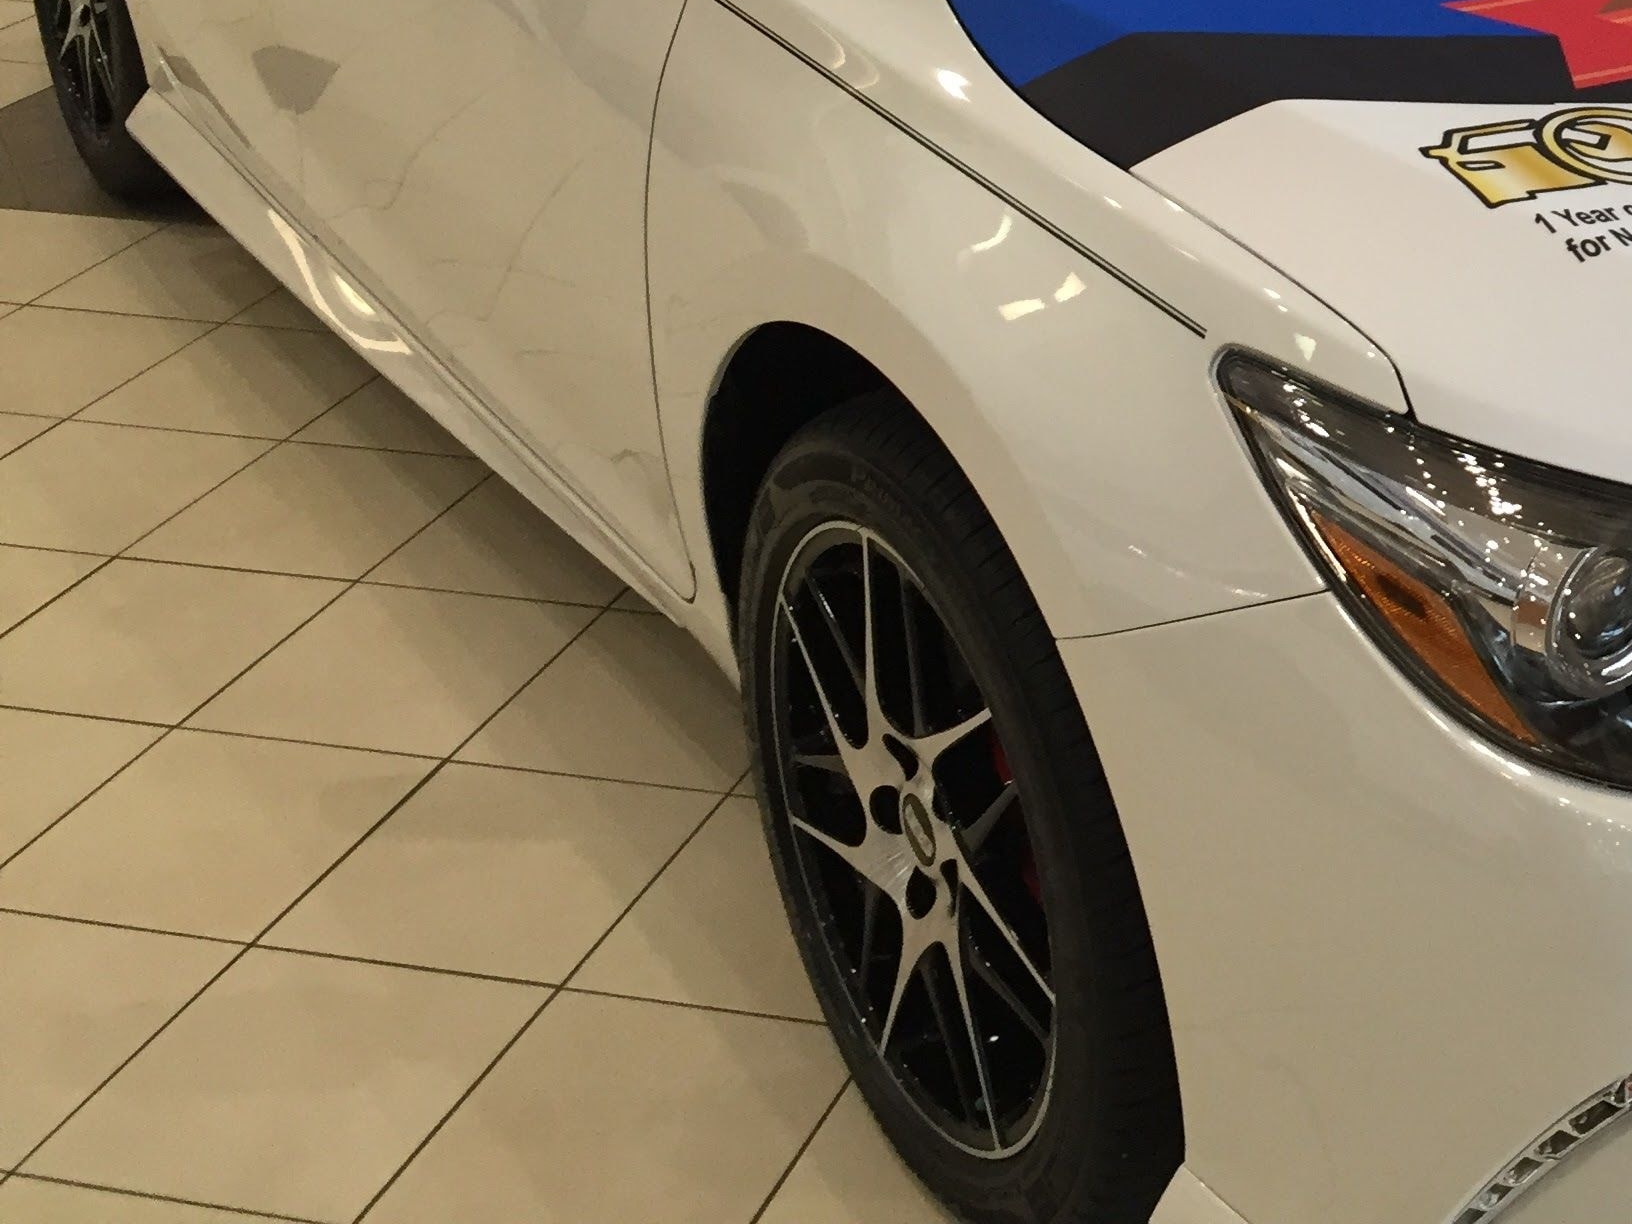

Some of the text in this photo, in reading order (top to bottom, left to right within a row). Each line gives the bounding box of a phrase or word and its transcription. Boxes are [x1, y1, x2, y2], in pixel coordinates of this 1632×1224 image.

[1534, 212, 1557, 234] 1
[1552, 207, 1616, 228] Year
[1565, 233, 1612, 263] for
